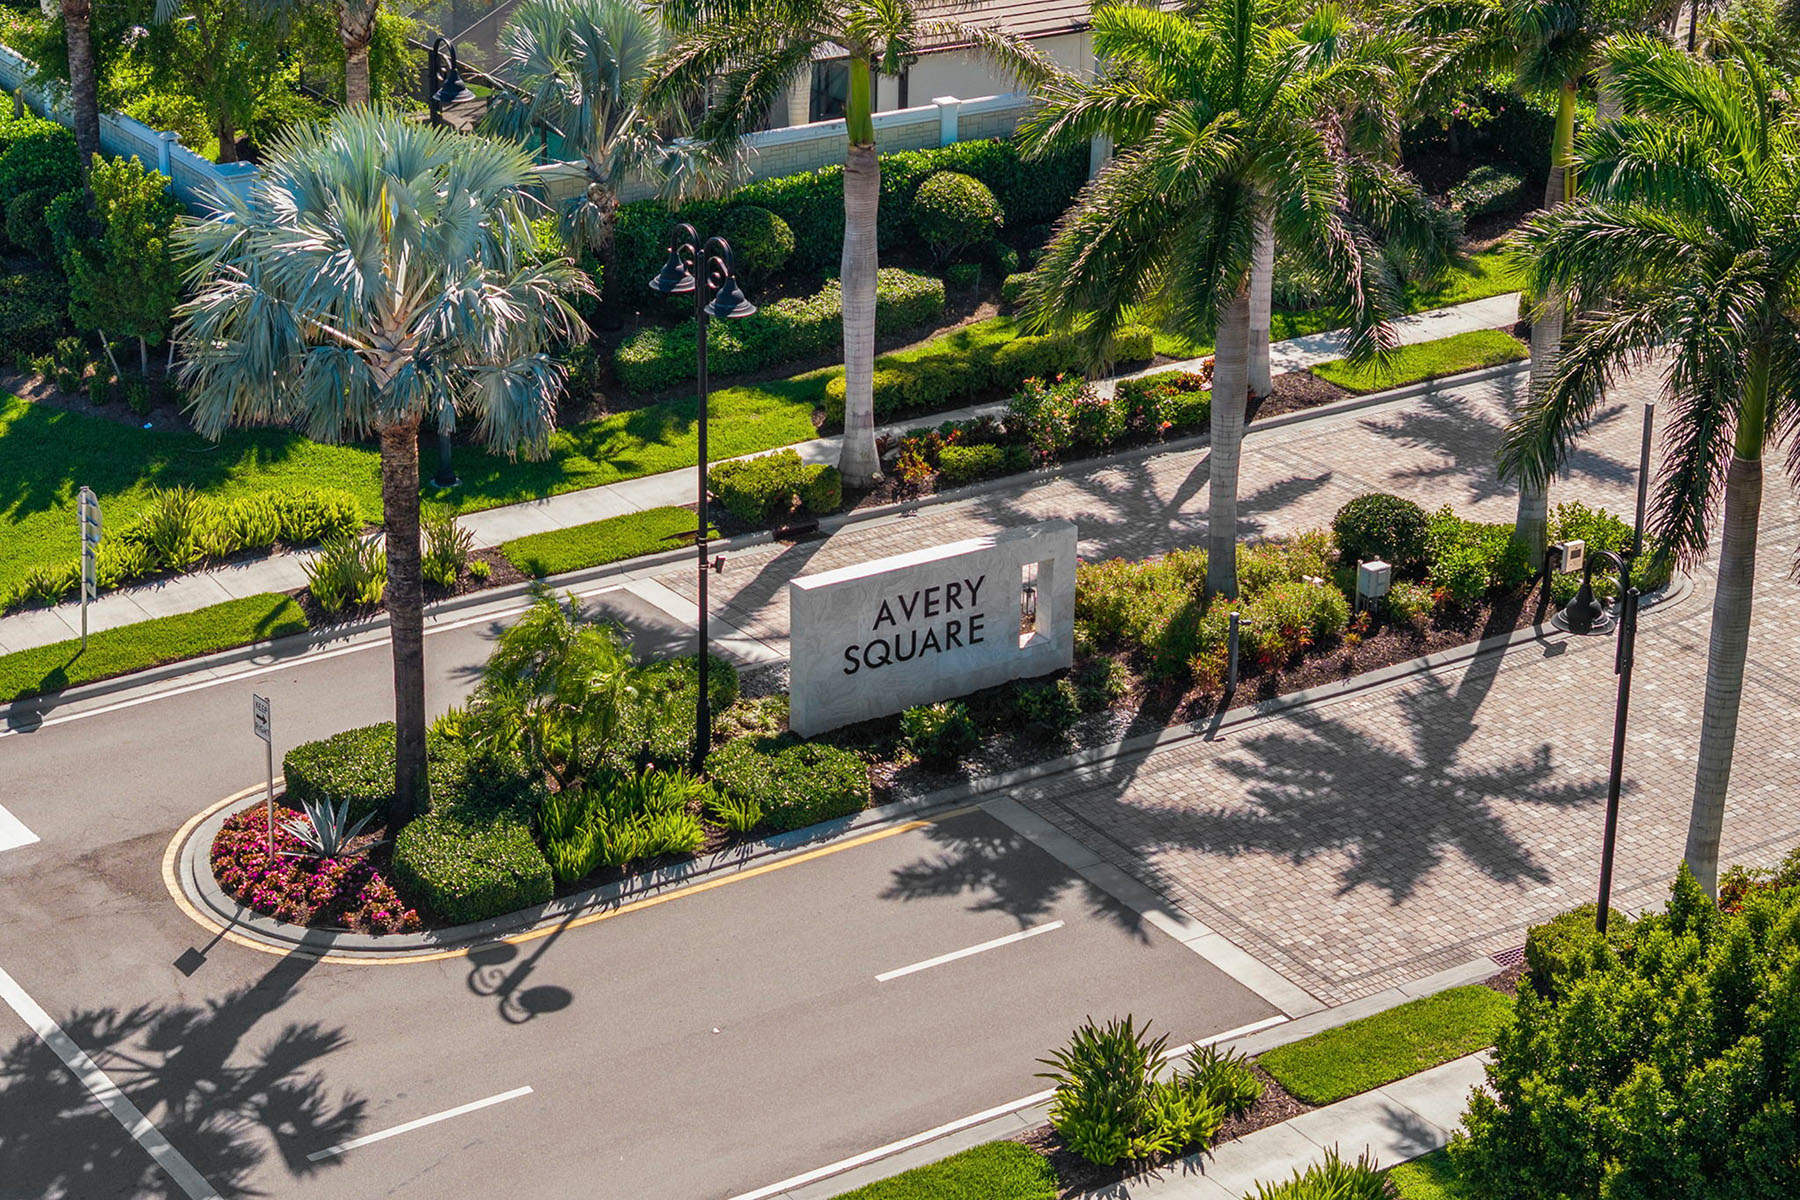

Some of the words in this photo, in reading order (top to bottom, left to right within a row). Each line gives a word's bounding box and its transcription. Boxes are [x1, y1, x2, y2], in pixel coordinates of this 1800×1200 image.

[872, 574, 986, 631] AVERY
[843, 613, 985, 676] SQUARE
[255, 701, 268, 714] KEEP
